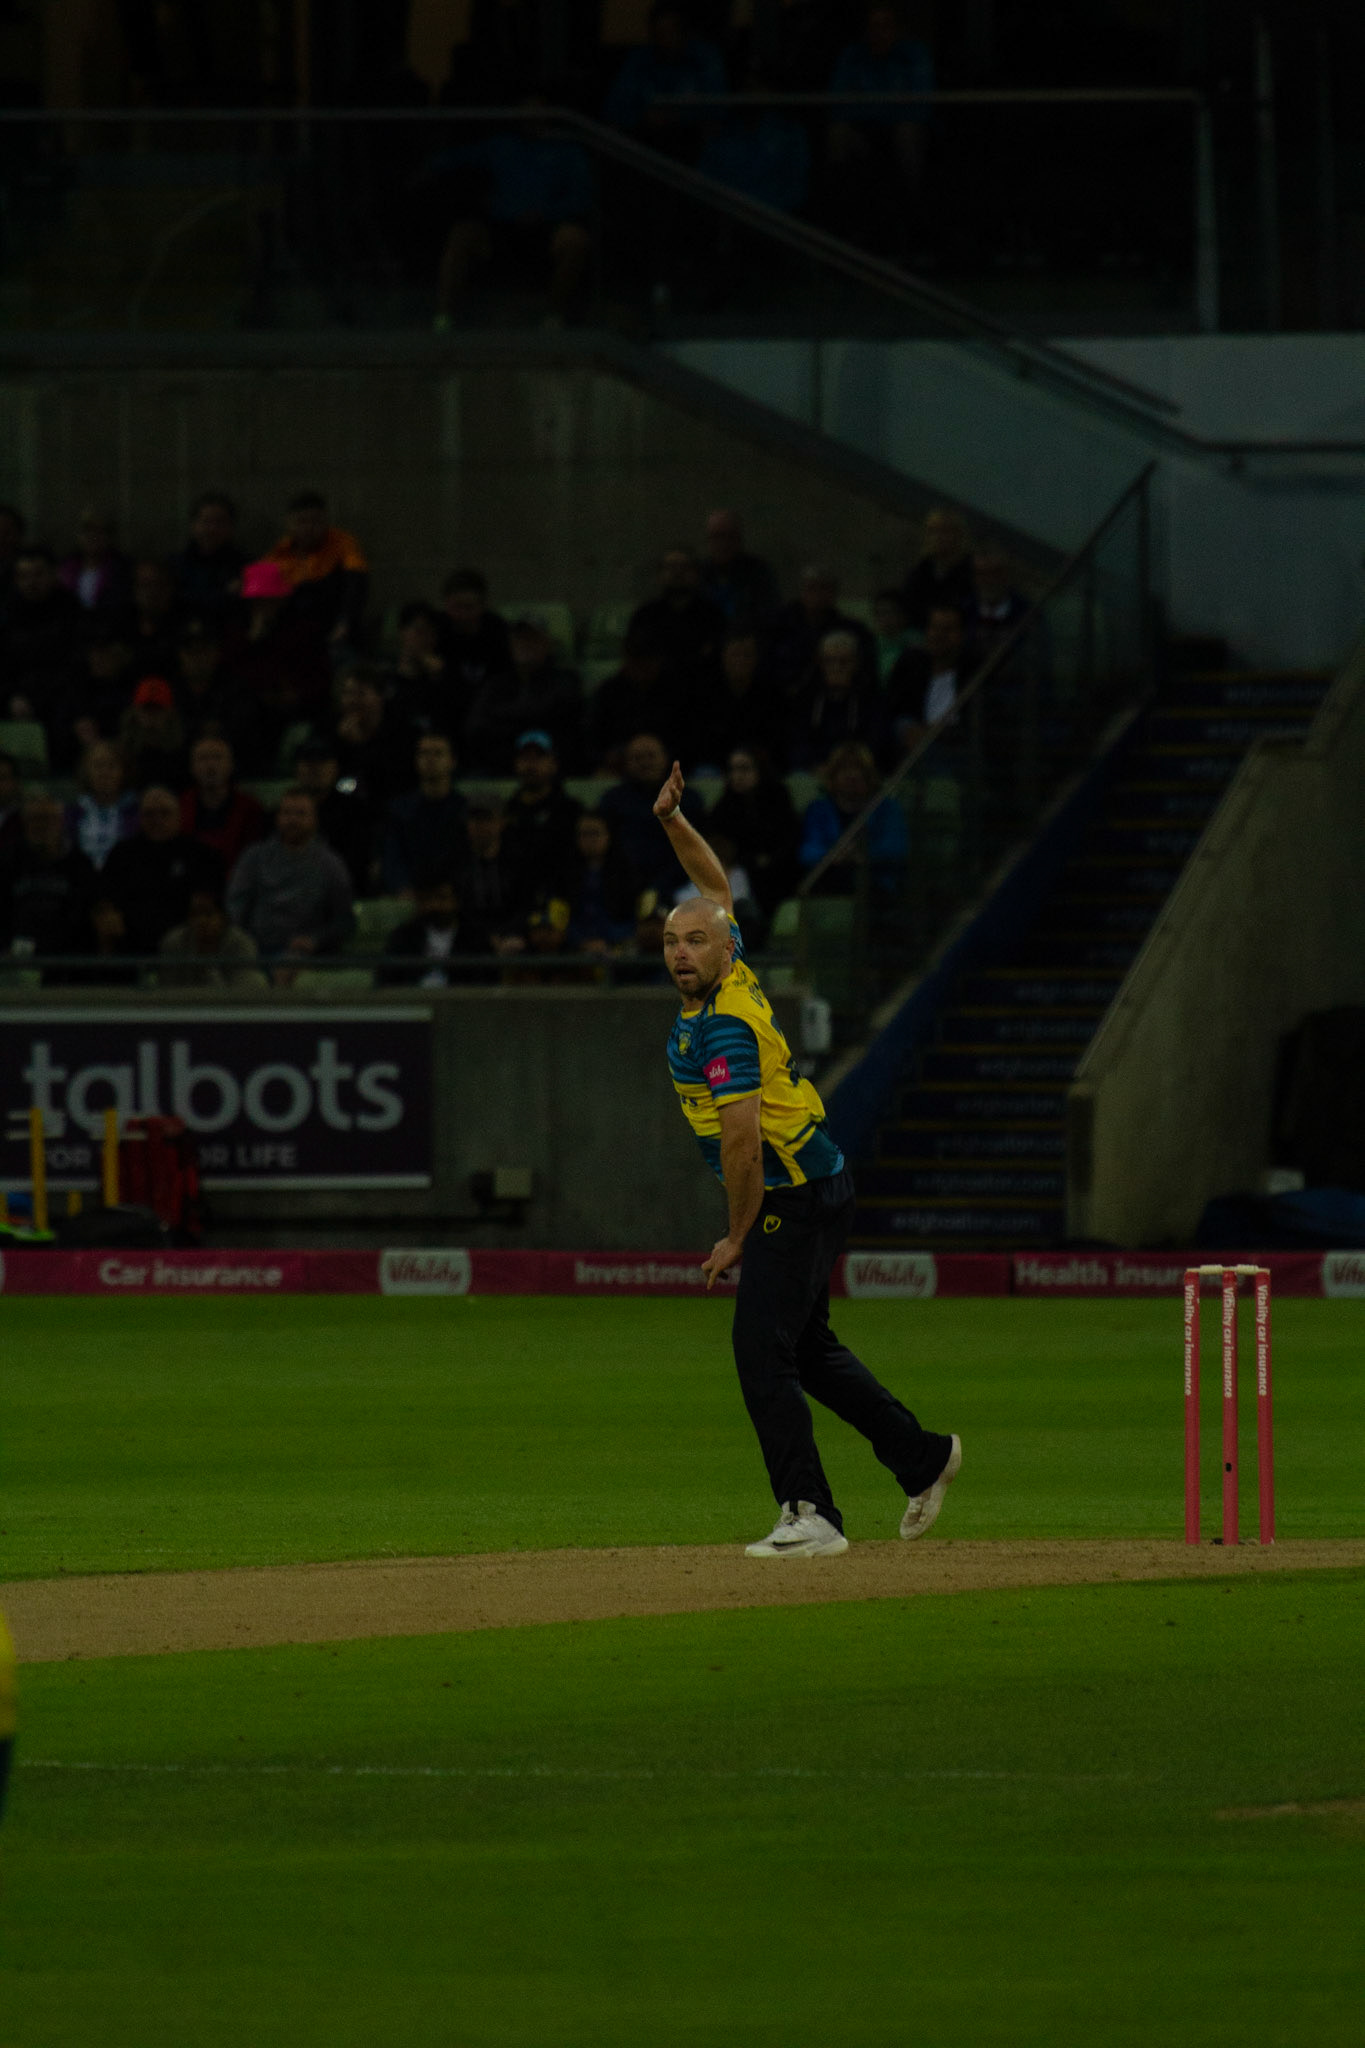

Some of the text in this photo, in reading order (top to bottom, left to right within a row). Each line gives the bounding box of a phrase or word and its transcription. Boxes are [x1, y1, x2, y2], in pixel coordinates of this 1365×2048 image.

[22, 1037, 405, 1134] talbots
[46, 1146, 91, 1170] OR
[235, 1143, 298, 1169] LIFE
[98, 1258, 148, 1286] Car
[575, 1259, 741, 1286] Investme
[1014, 1257, 1108, 1287] Health
[1185, 1343, 1194, 1396] insurance
[1223, 1345, 1234, 1398] insurance
[1258, 1344, 1269, 1396] insurance
